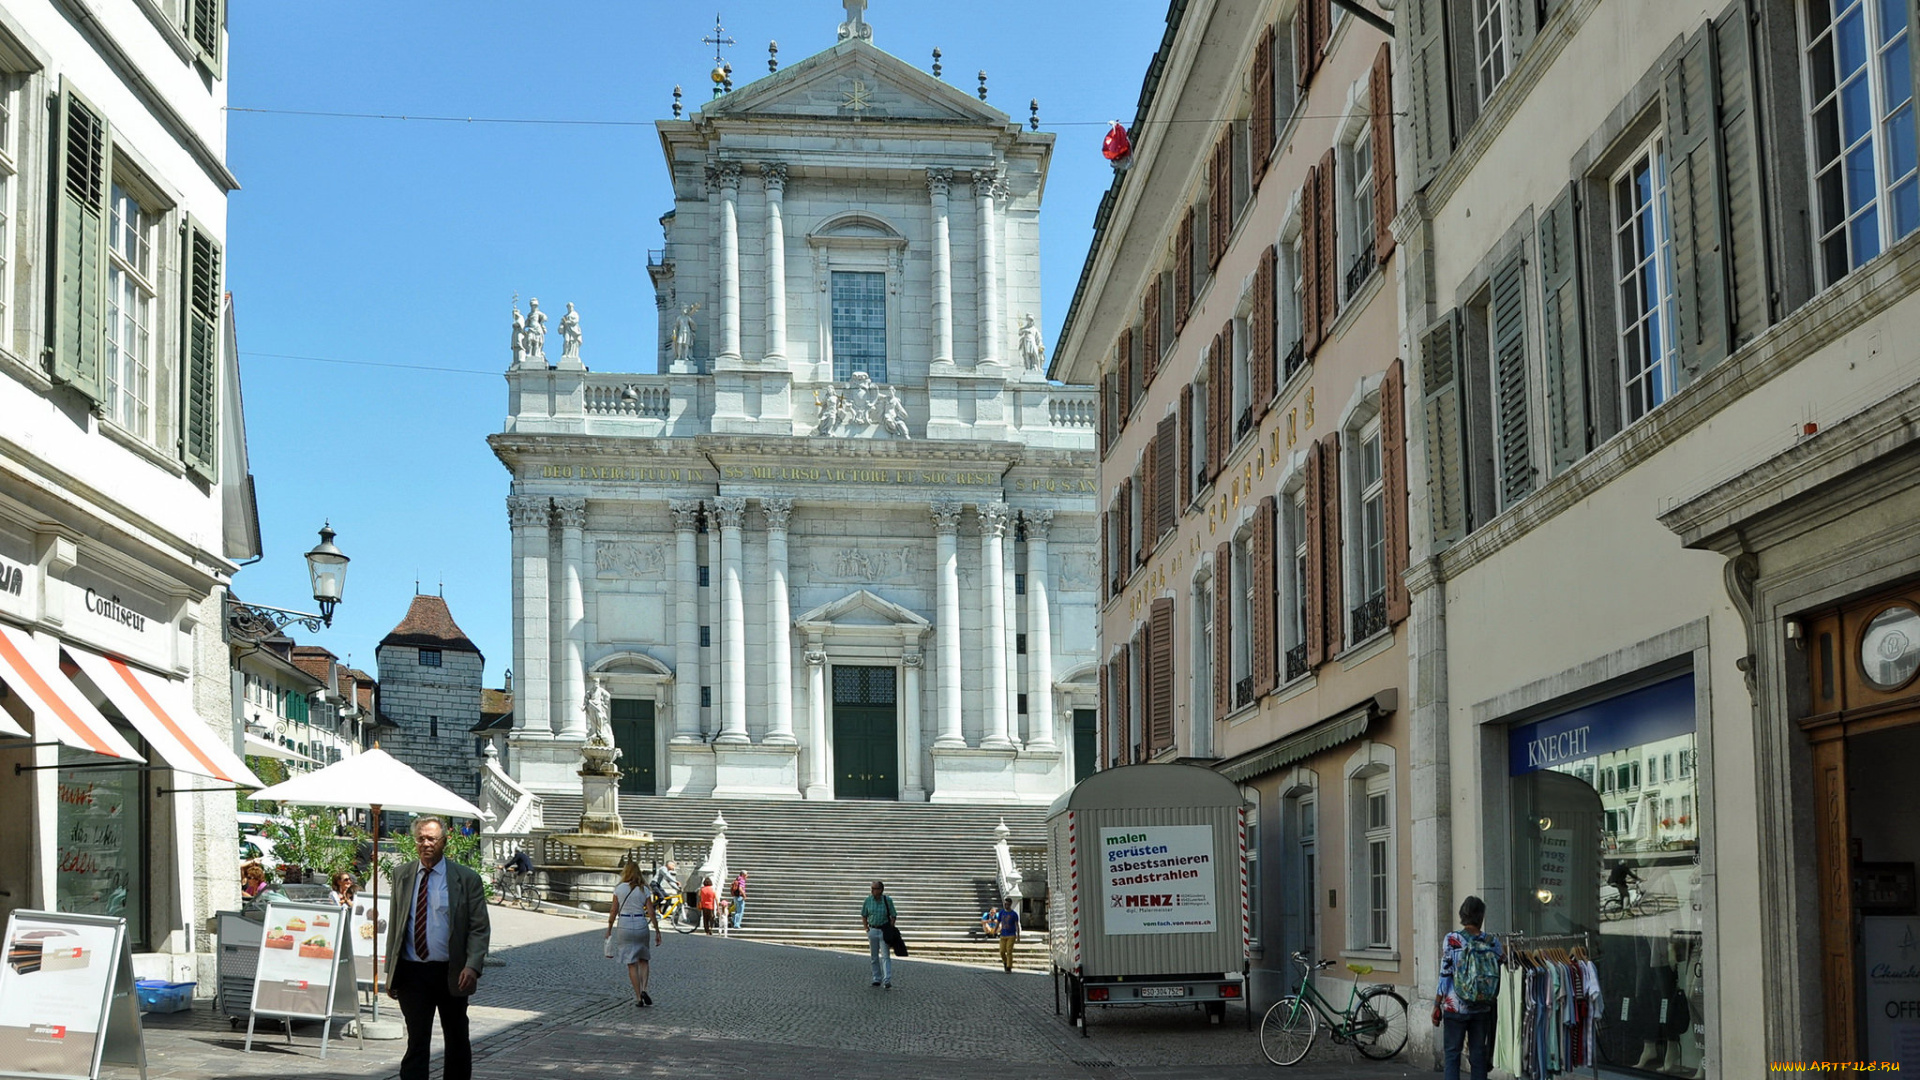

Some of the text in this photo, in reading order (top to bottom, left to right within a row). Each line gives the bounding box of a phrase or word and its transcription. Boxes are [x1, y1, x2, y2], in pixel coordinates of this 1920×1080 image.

[1209, 386, 1315, 537] COURONNE
[543, 465, 572, 479] DEO
[826, 469, 889, 482] VICTORE
[897, 471, 914, 483] ET
[84, 587, 146, 633] Confiseur
[1528, 725, 1590, 768] KNECHT
[1106, 833, 1147, 846] malen
[1108, 845, 1168, 862] gerüsten
[1110, 854, 1209, 873] asbestsanieren
[1112, 869, 1198, 887] sandstrahlen
[1126, 894, 1173, 907] MENZ
